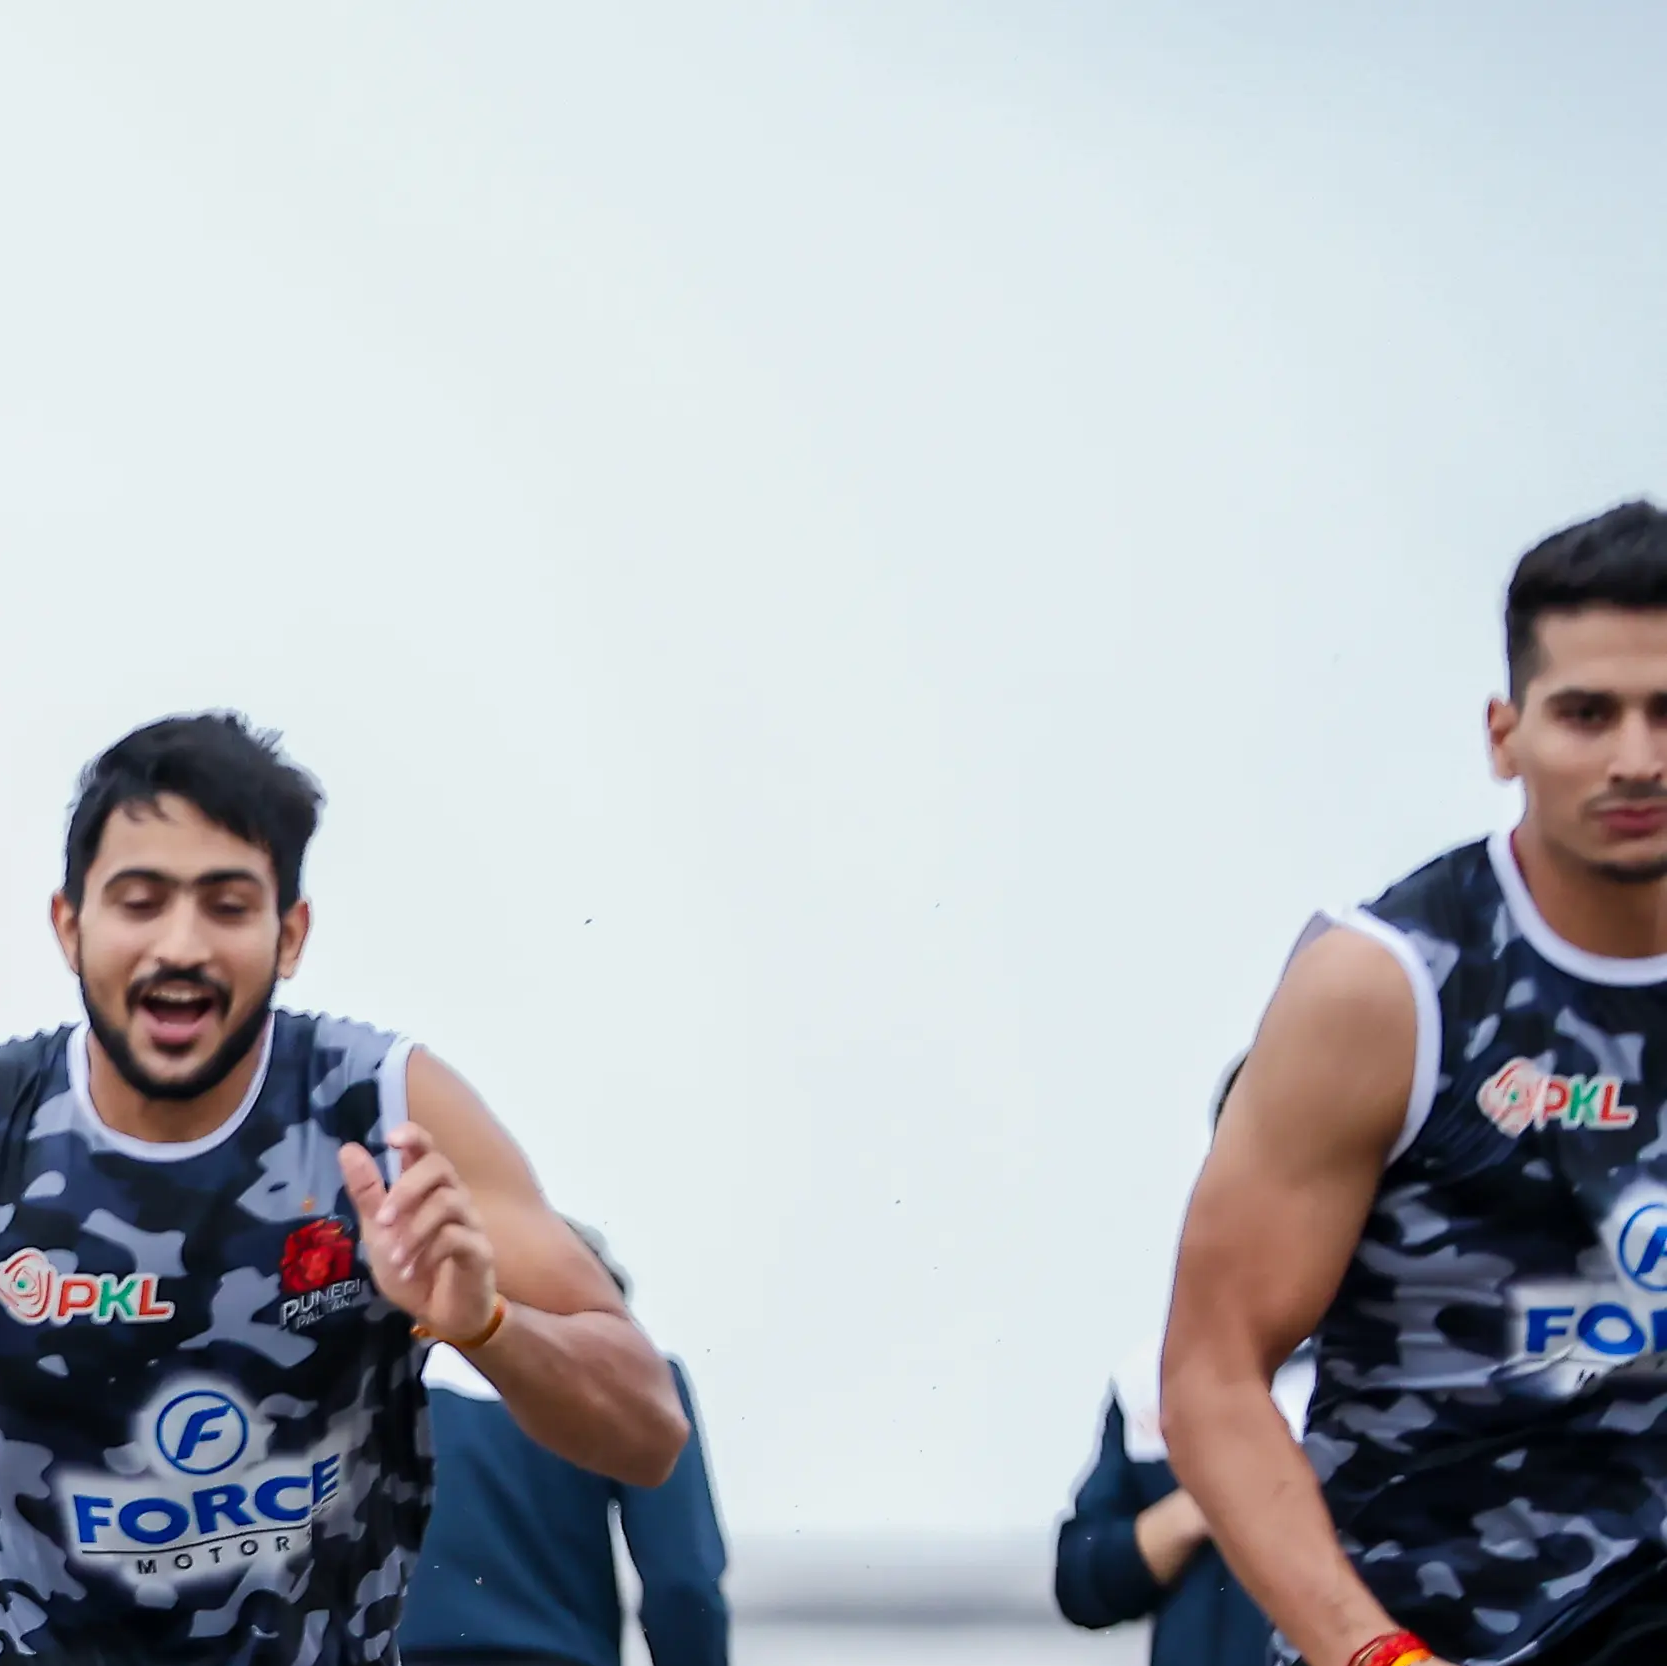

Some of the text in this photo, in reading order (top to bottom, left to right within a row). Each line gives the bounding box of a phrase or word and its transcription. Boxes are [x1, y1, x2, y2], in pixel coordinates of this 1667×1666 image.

[1540, 1080, 1633, 1124] PKL
[57, 1275, 172, 1320] PKL
[280, 1278, 361, 1327] PUNERI
[72, 1453, 341, 1545] FORCE
